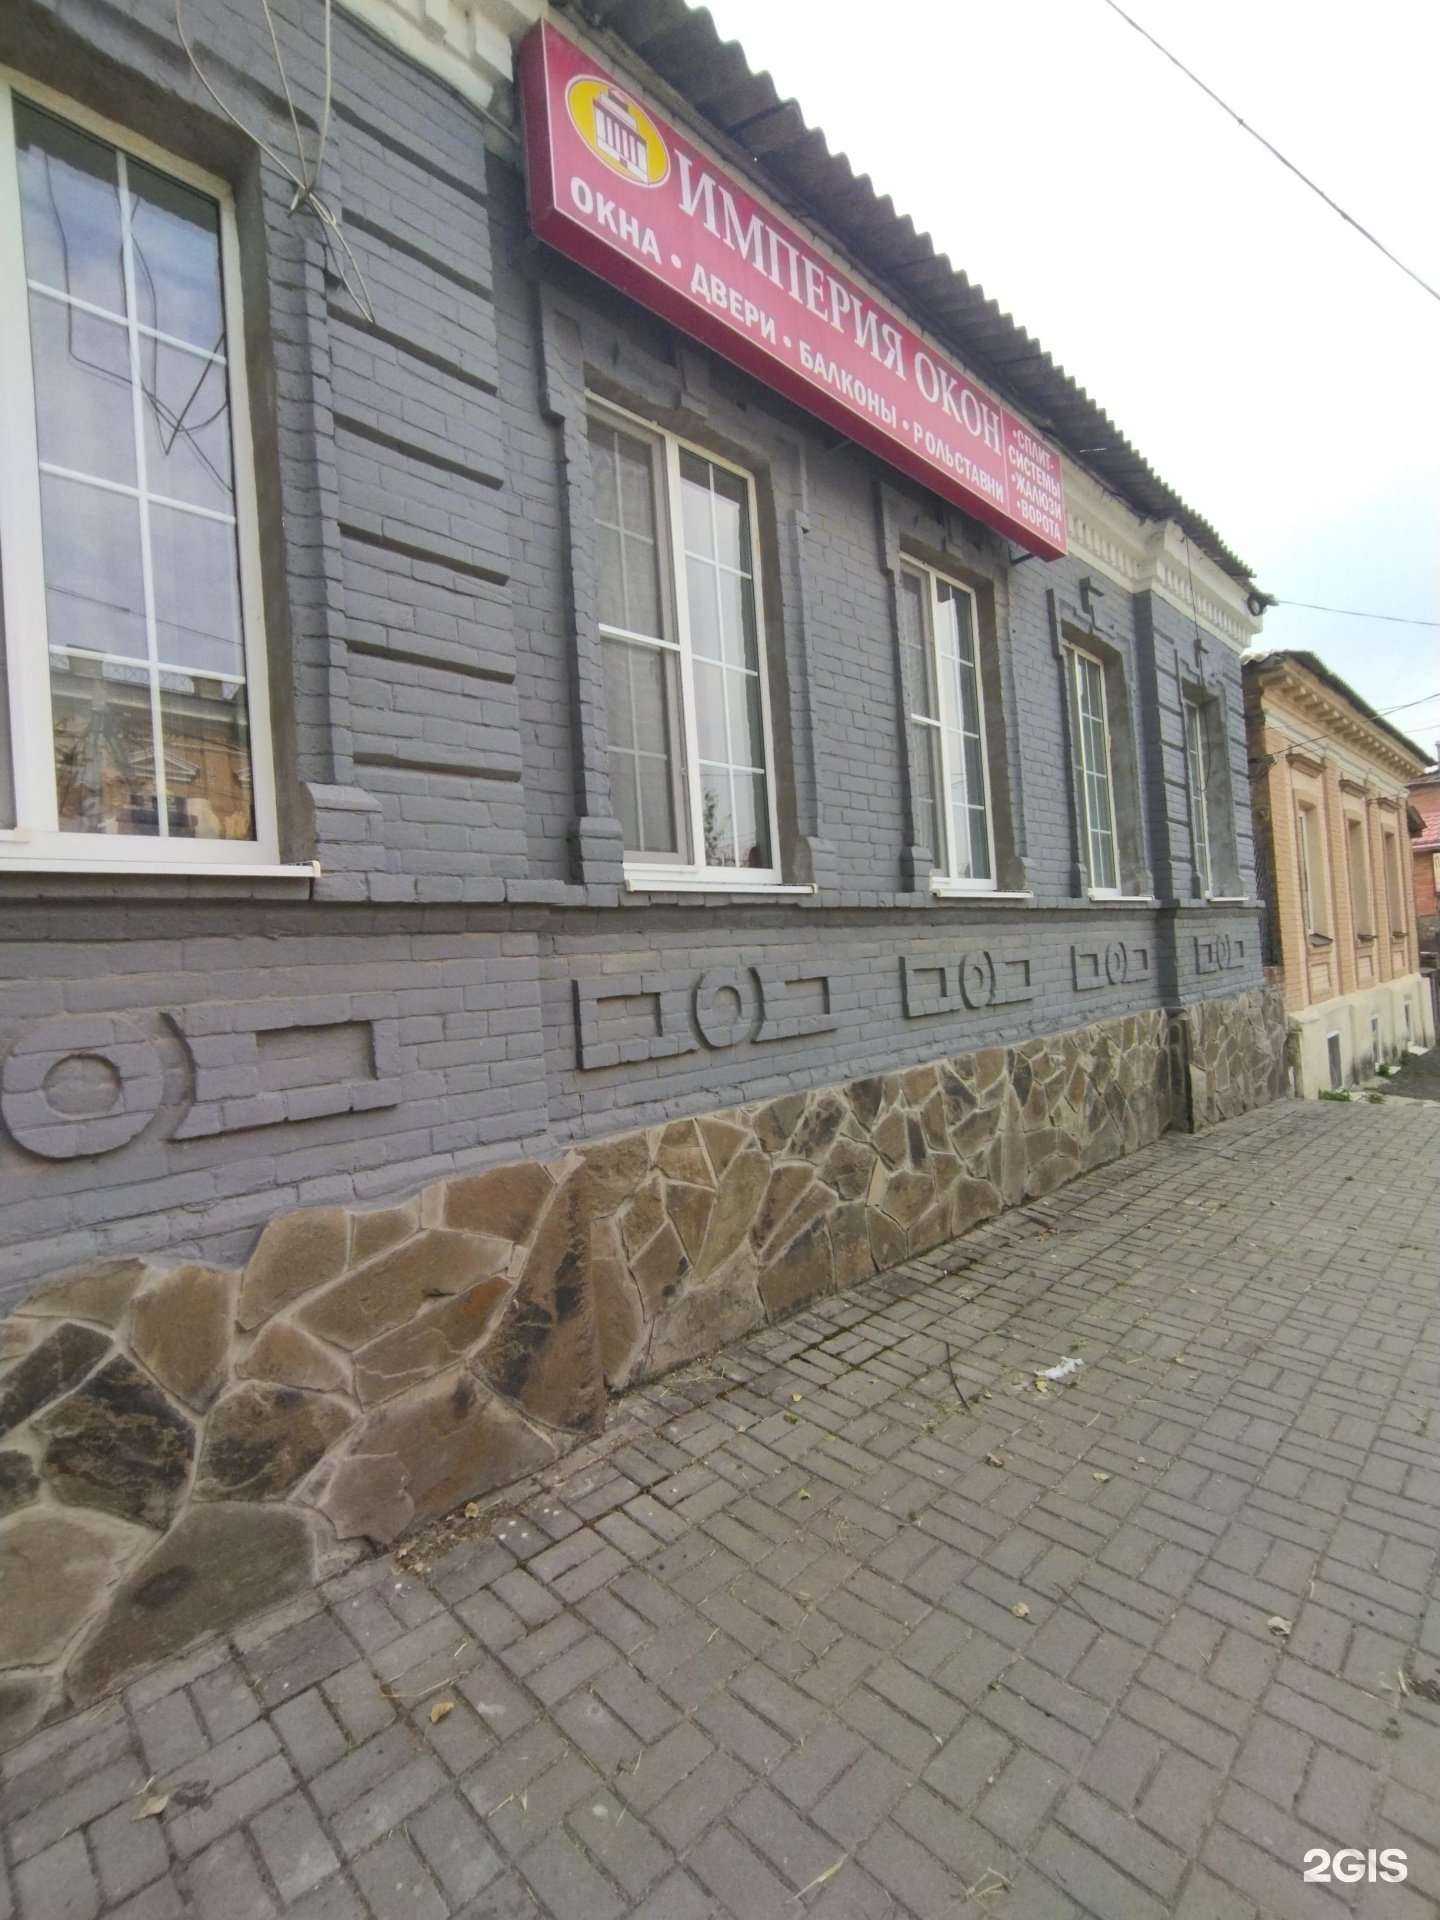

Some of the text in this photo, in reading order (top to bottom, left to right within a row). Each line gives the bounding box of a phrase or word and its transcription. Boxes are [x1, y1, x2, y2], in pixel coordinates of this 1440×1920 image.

[570, 176, 1004, 504] ОКНА ДВЕРИ БАЛКОНЫ РОЛЬСТАВНИ
[674, 149, 1002, 456] ИМПЕРИЯ ОКОН
[1008, 443, 1061, 499] СИСТЕМЫ
